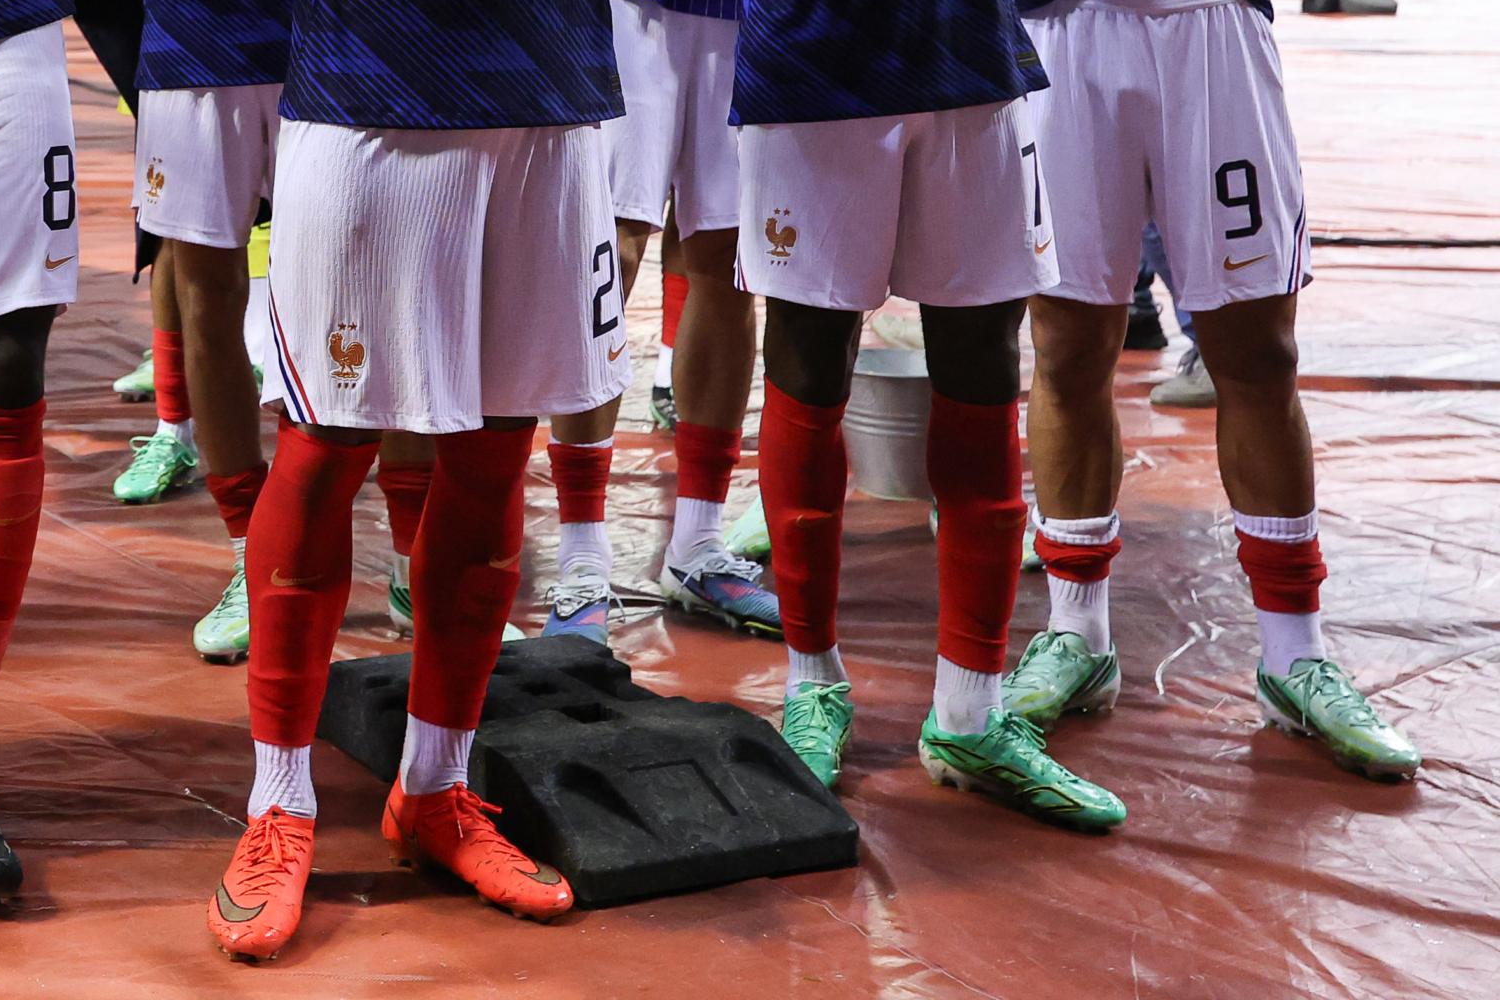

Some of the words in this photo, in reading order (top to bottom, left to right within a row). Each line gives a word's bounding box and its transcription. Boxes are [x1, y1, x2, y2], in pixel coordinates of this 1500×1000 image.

[43, 146, 75, 230] 8
[1021, 142, 1041, 227] 7
[1215, 160, 1262, 239] 9
[593, 240, 624, 338] 2
